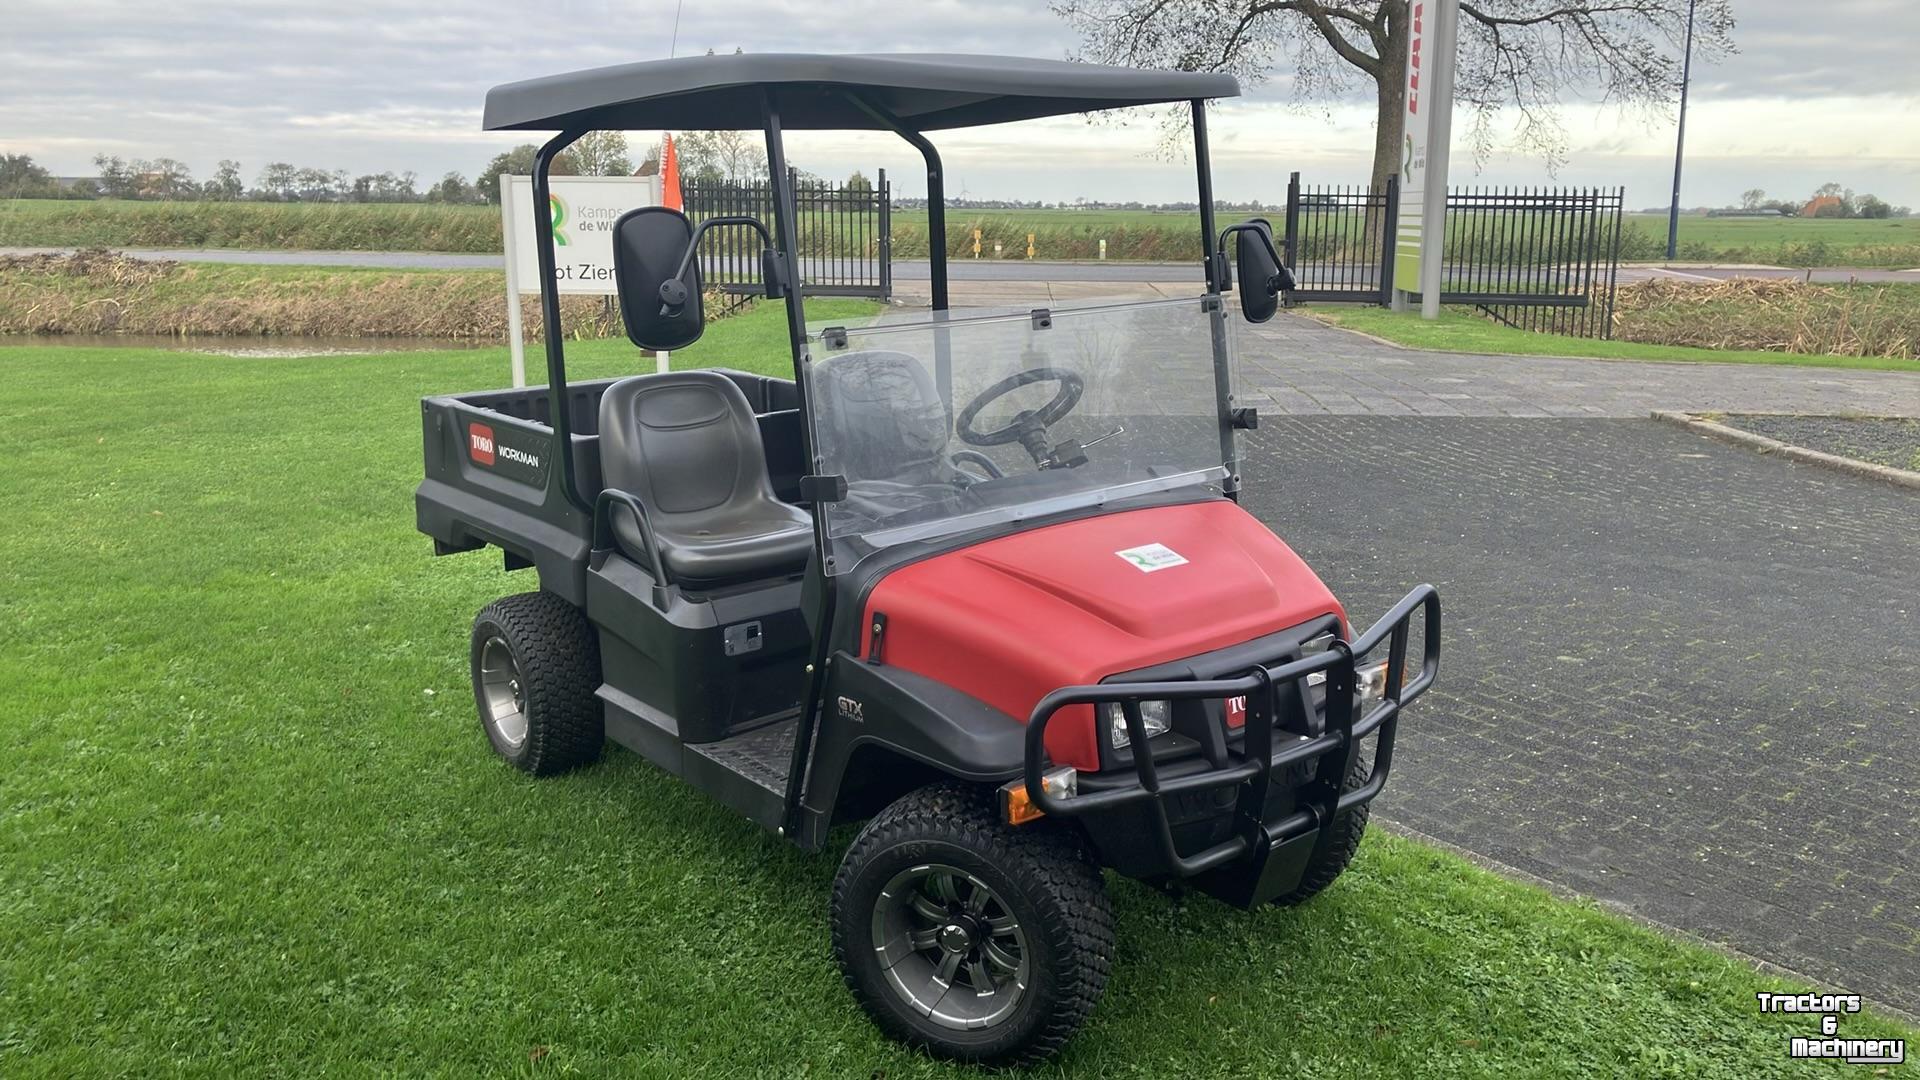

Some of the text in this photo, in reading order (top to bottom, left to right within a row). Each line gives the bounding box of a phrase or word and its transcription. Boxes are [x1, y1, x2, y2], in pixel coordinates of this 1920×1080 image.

[579, 221, 593, 232] de
[555, 265, 573, 280] ot
[498, 445, 539, 468] WORKMAN
[838, 696, 863, 717] GTX
[1228, 695, 1246, 714] TO
